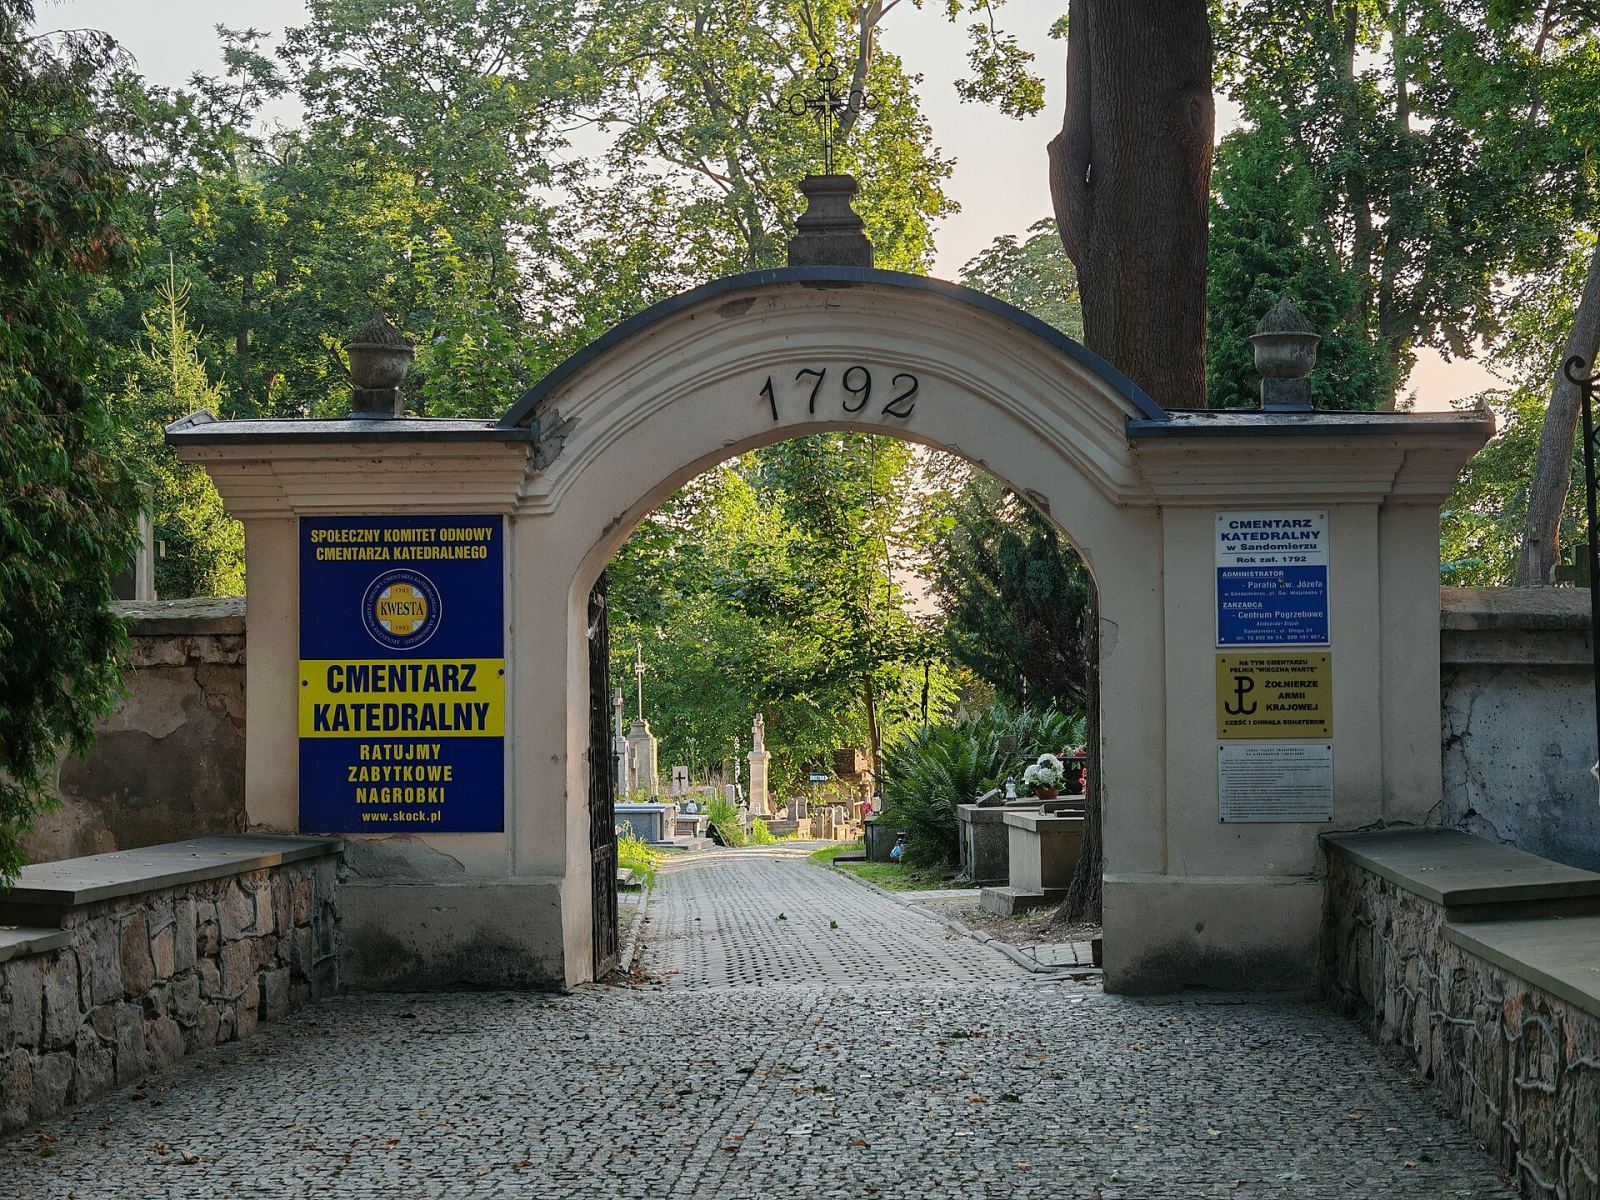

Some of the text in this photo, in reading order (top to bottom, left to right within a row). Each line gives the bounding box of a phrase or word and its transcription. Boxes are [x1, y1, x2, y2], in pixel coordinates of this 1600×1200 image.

[759, 366, 919, 420] 1792
[1229, 519, 1312, 529] CMENTARZ
[311, 527, 492, 543] SPOŁECZNY KOMITET ODNOWY
[1220, 530, 1320, 541] KATEDRALNY
[316, 545, 487, 561] CMENTARZA KATEDRALNEGO
[1240, 542, 1317, 550] Sandomierzu
[1297, 580, 1322, 588] Józefa
[380, 601, 424, 616] KWESTA
[1275, 611, 1323, 619] Pogrzebowe
[327, 664, 476, 693] CMENTARZ
[1264, 679, 1318, 688] ŻOŁNIERZE
[313, 702, 490, 732] KATEDRALNY
[360, 744, 440, 760] RATUJMY
[348, 766, 453, 782] ZABYTKOWE
[356, 787, 444, 803] NAGROBKI
[362, 811, 441, 823] www.skock.pl
